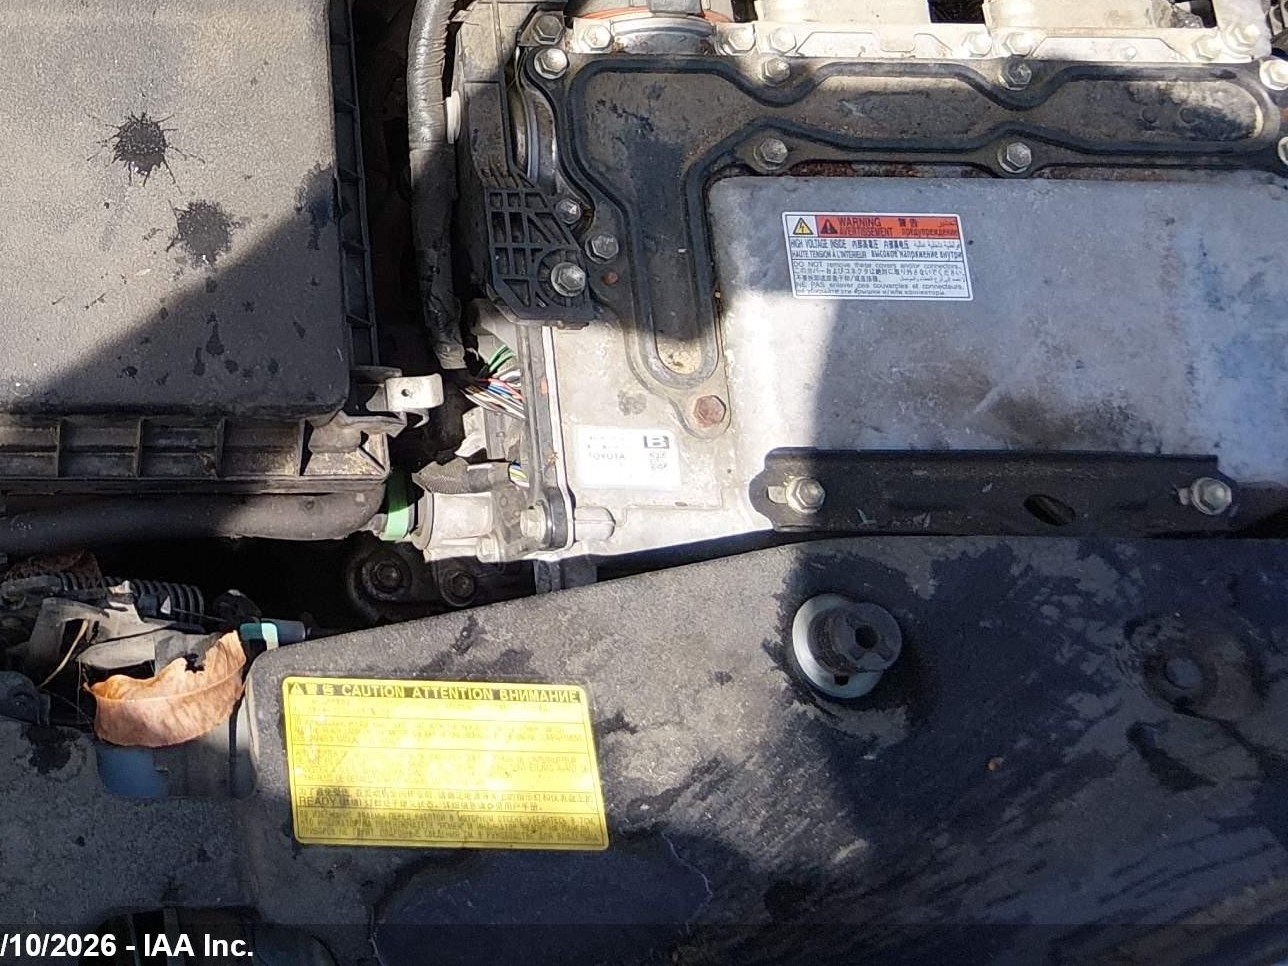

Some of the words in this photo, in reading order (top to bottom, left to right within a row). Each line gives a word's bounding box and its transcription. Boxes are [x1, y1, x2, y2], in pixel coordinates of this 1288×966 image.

[838, 217, 881, 227] WARNING
[839, 227, 893, 236] AVERTISSEMENT
[805, 239, 828, 248] VOLTAGE
[342, 684, 405, 698] CAUTION
[412, 686, 494, 700] ATTENTION
[500, 688, 579, 703] ВНИМАНИЕ
